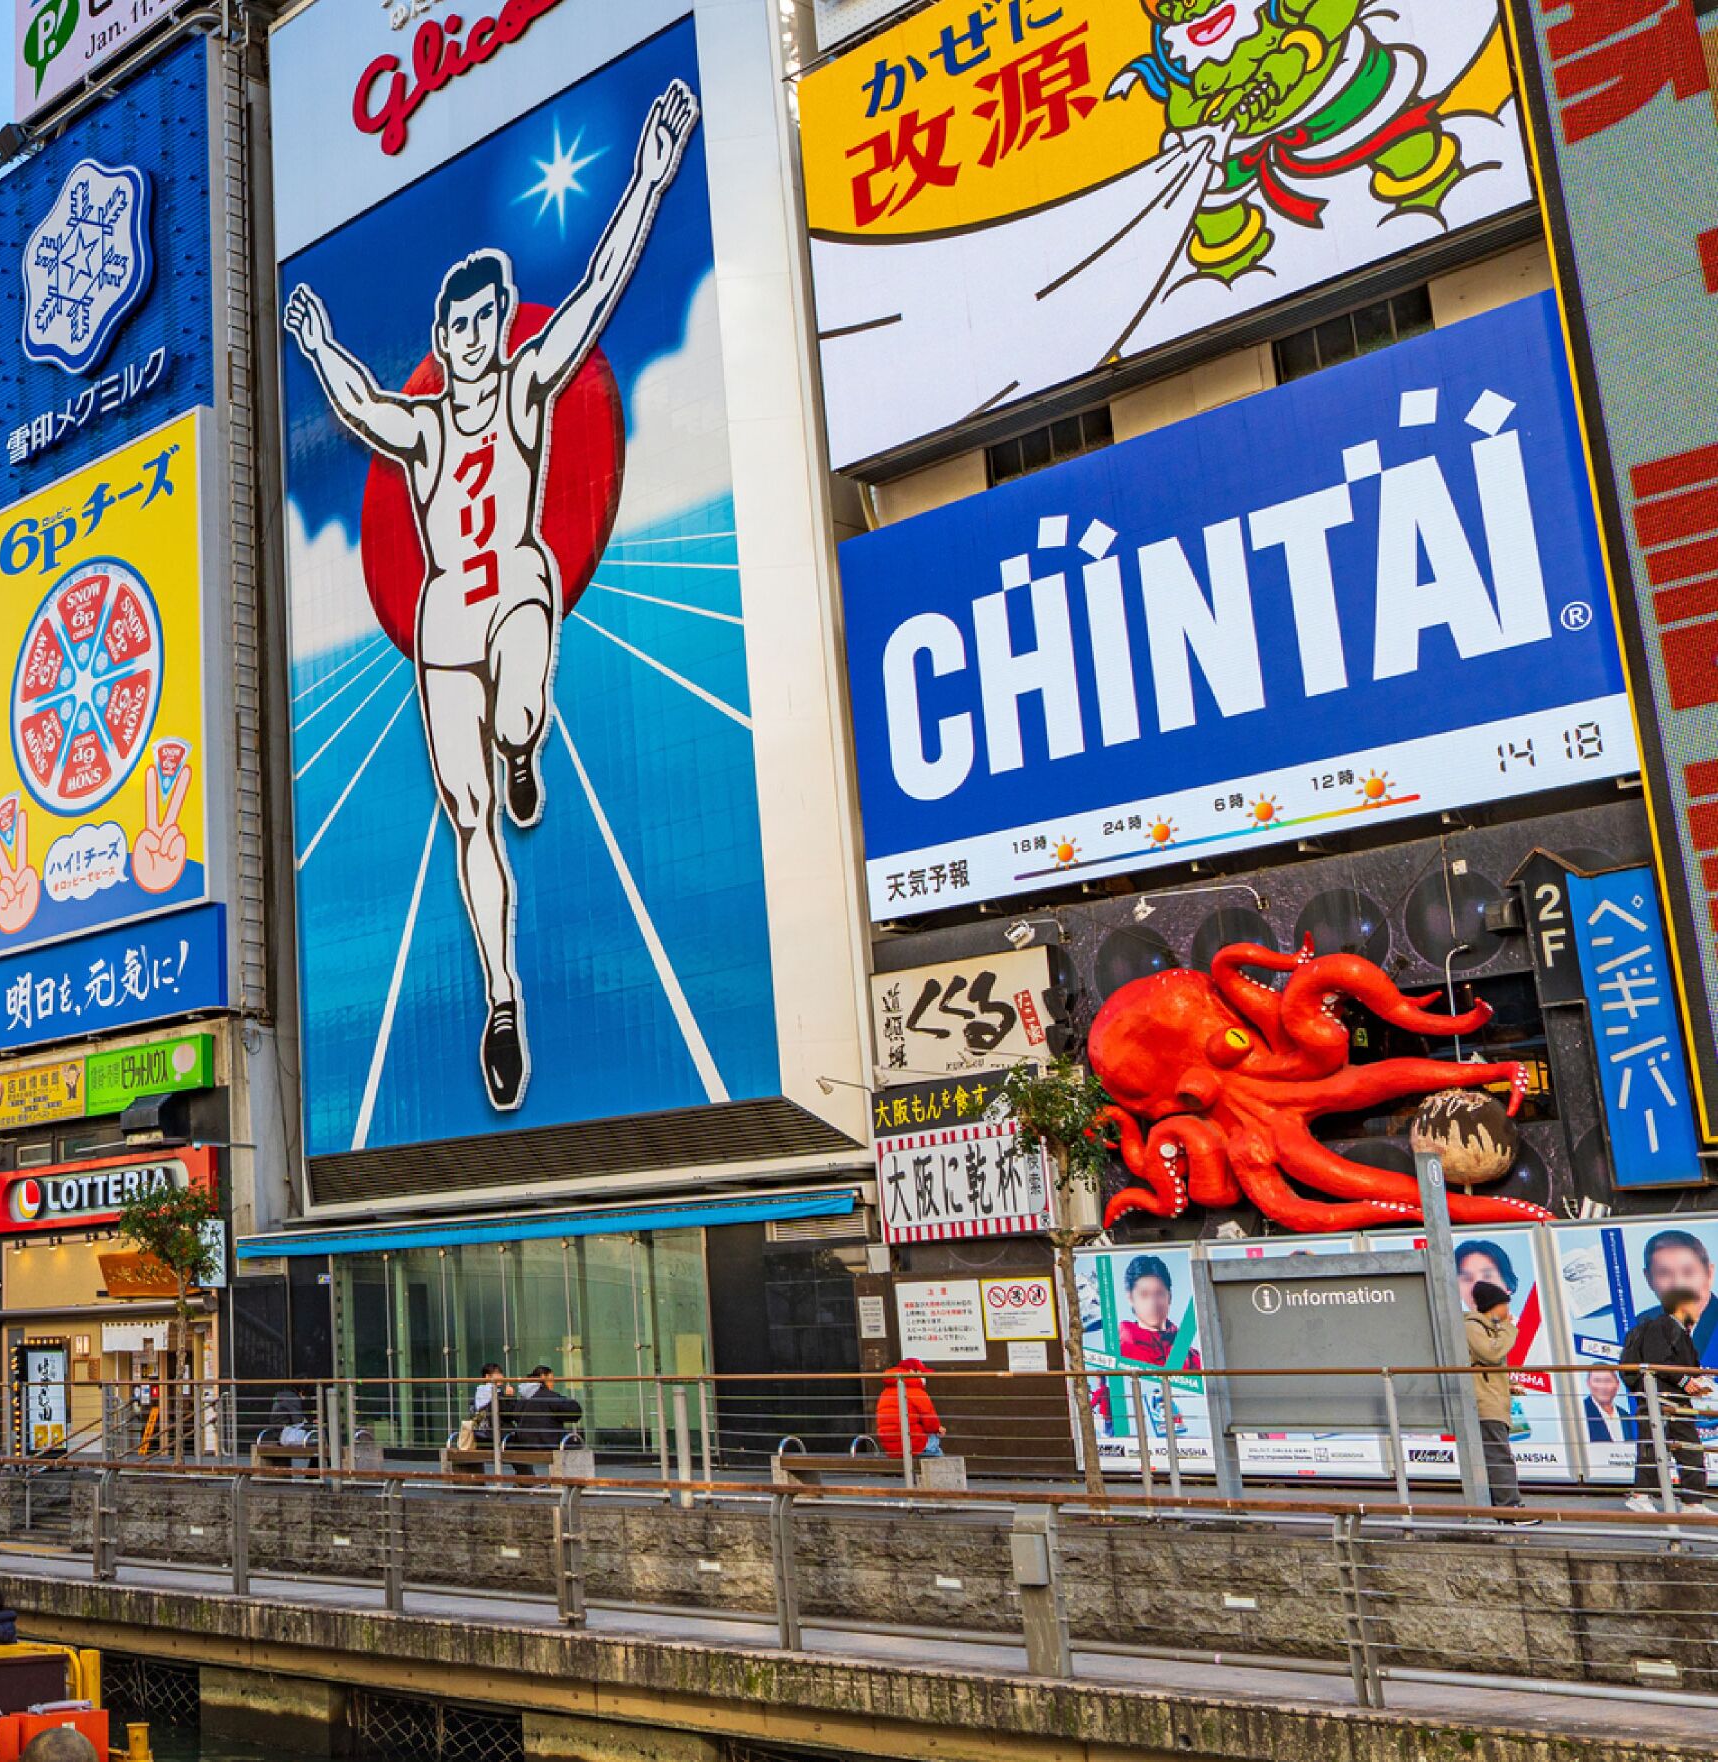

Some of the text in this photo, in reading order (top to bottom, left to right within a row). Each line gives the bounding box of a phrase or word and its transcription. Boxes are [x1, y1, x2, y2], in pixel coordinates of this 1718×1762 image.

[85, 21, 128, 60] Jan.
[861, 0, 1063, 118] かぜに
[845, 20, 1099, 227] 改源
[7, 346, 167, 464] 雪印メグミルク
[453, 431, 499, 607] グリコ
[66, 580, 102, 609] SNOW
[882, 387, 1552, 801] CHINTAI
[1213, 791, 1245, 812] 6時
[1309, 768, 1355, 791] 12時
[1011, 836, 1047, 855] 18時
[1102, 814, 1143, 836] 24時
[885, 860, 971, 902] 天気予報
[1535, 883, 1566, 968] 2F
[882, 983, 907, 1068] 道頓堀
[906, 970, 1018, 1056] くくる
[1587, 895, 1678, 1153] ペンギンバー
[47, 1167, 169, 1210] LOTTERIA
[884, 1141, 1023, 1222] 大阪に乾杯
[1286, 1286, 1395, 1307] information
